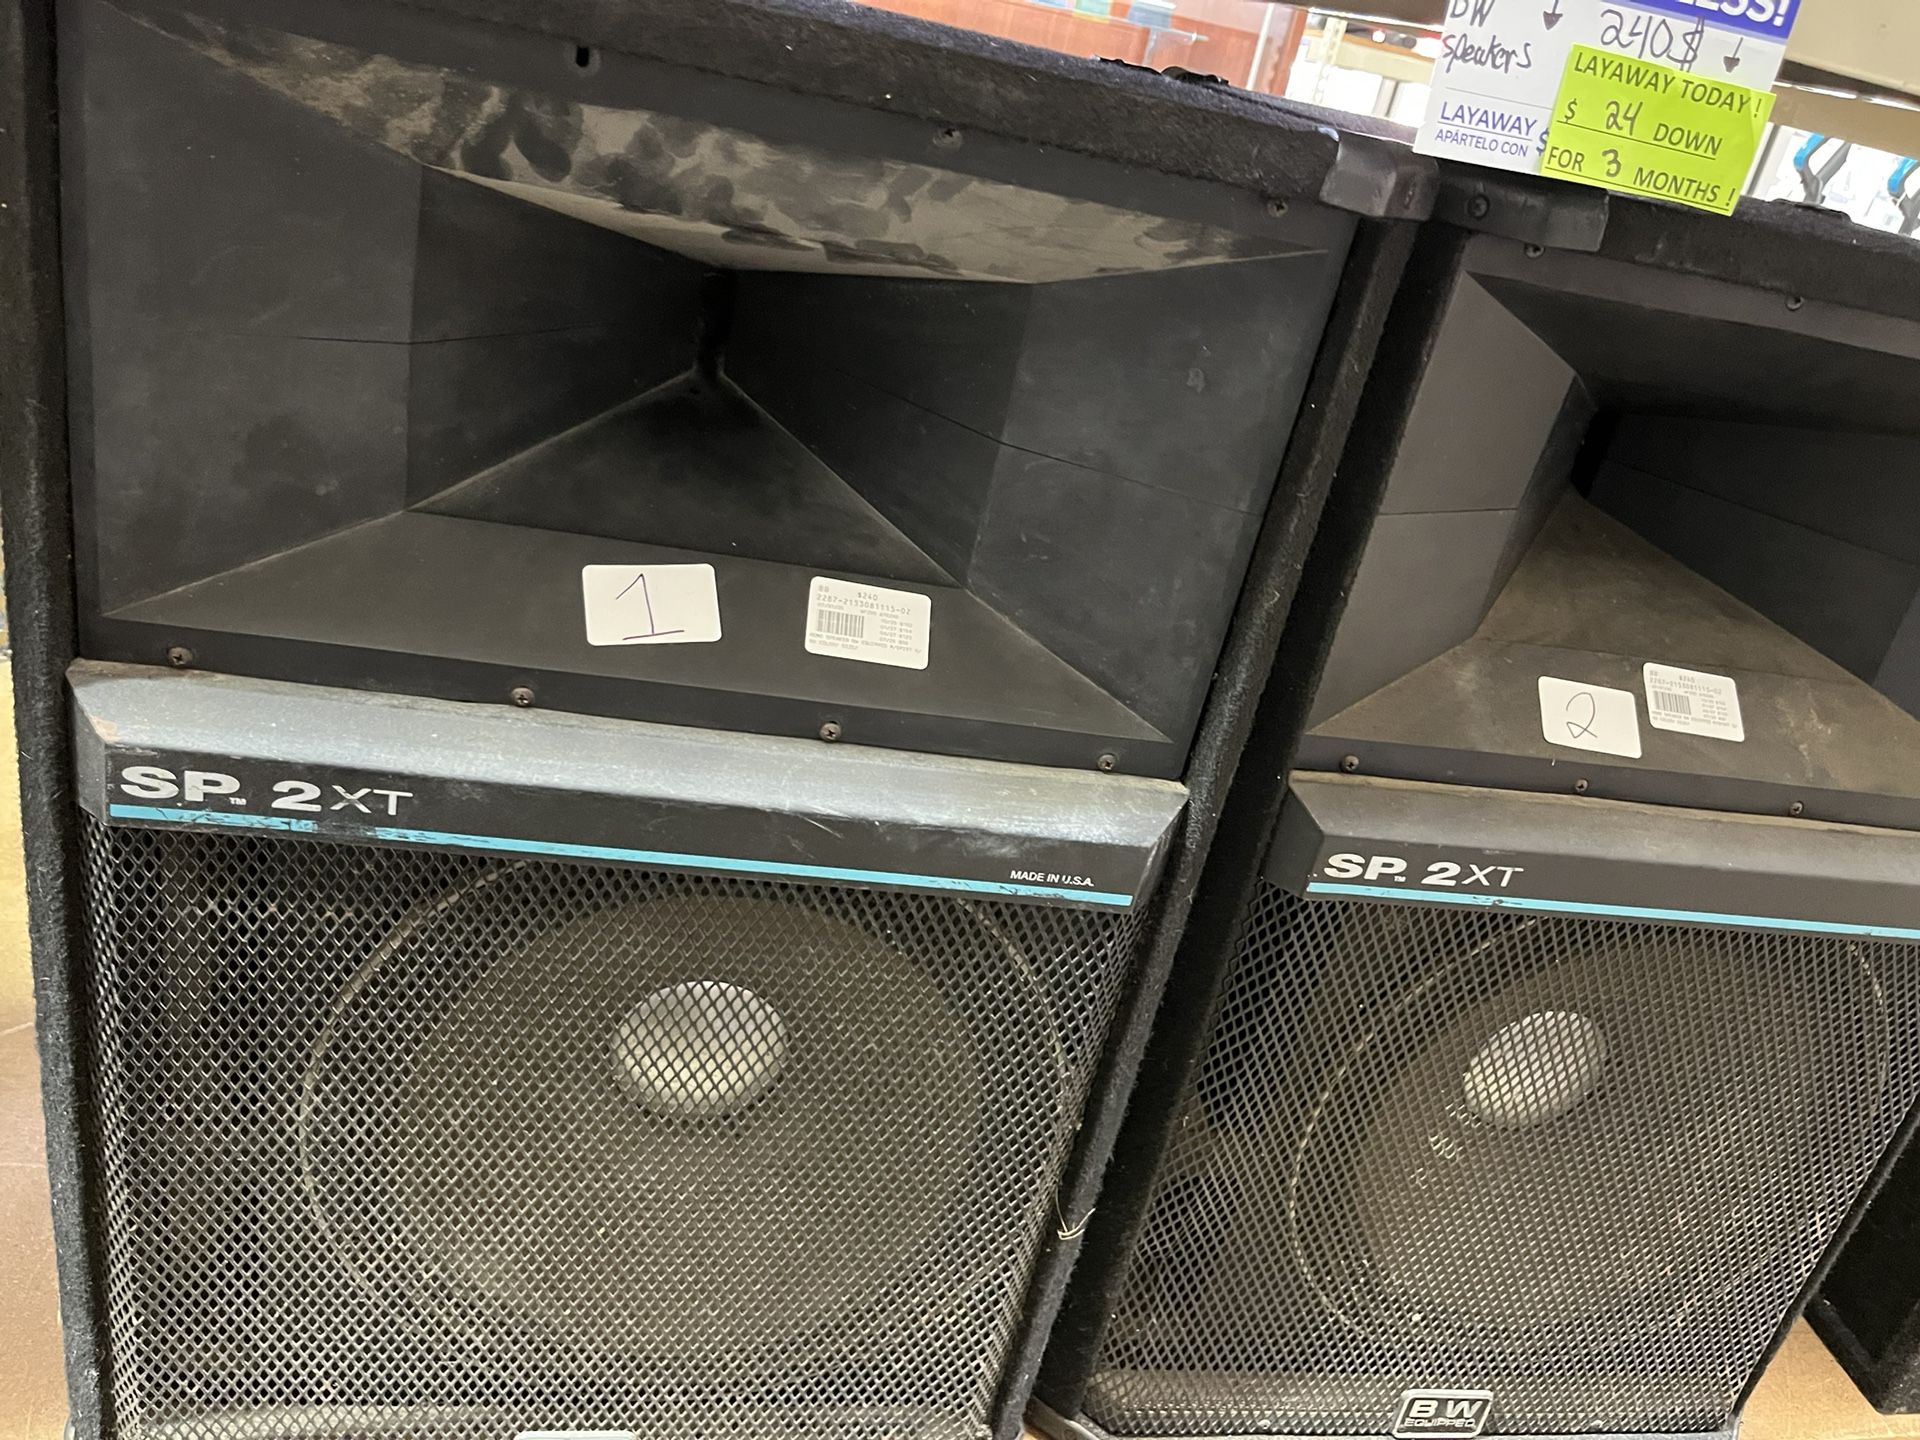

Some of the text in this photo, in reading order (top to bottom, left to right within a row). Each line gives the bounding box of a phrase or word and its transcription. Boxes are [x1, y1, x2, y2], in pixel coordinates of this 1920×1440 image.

[1574, 52, 1676, 94] LAYAWAY
[1681, 79, 1751, 114] TODAY
[1440, 101, 1538, 136] LAYAWAY
[1564, 98, 1723, 155] $ 24 DOWN
[1435, 129, 1528, 157] APÁRTELO CON
[1548, 146, 1585, 172] FOR
[1601, 148, 1622, 177] 3
[1633, 166, 1721, 202] MONTHS
[616, 573, 685, 640] 1
[1566, 691, 1598, 739] 2
[1010, 870, 1045, 882] MADE
[1046, 873, 1060, 883] IN
[1404, 1417, 1476, 1428] EQUIPPED
